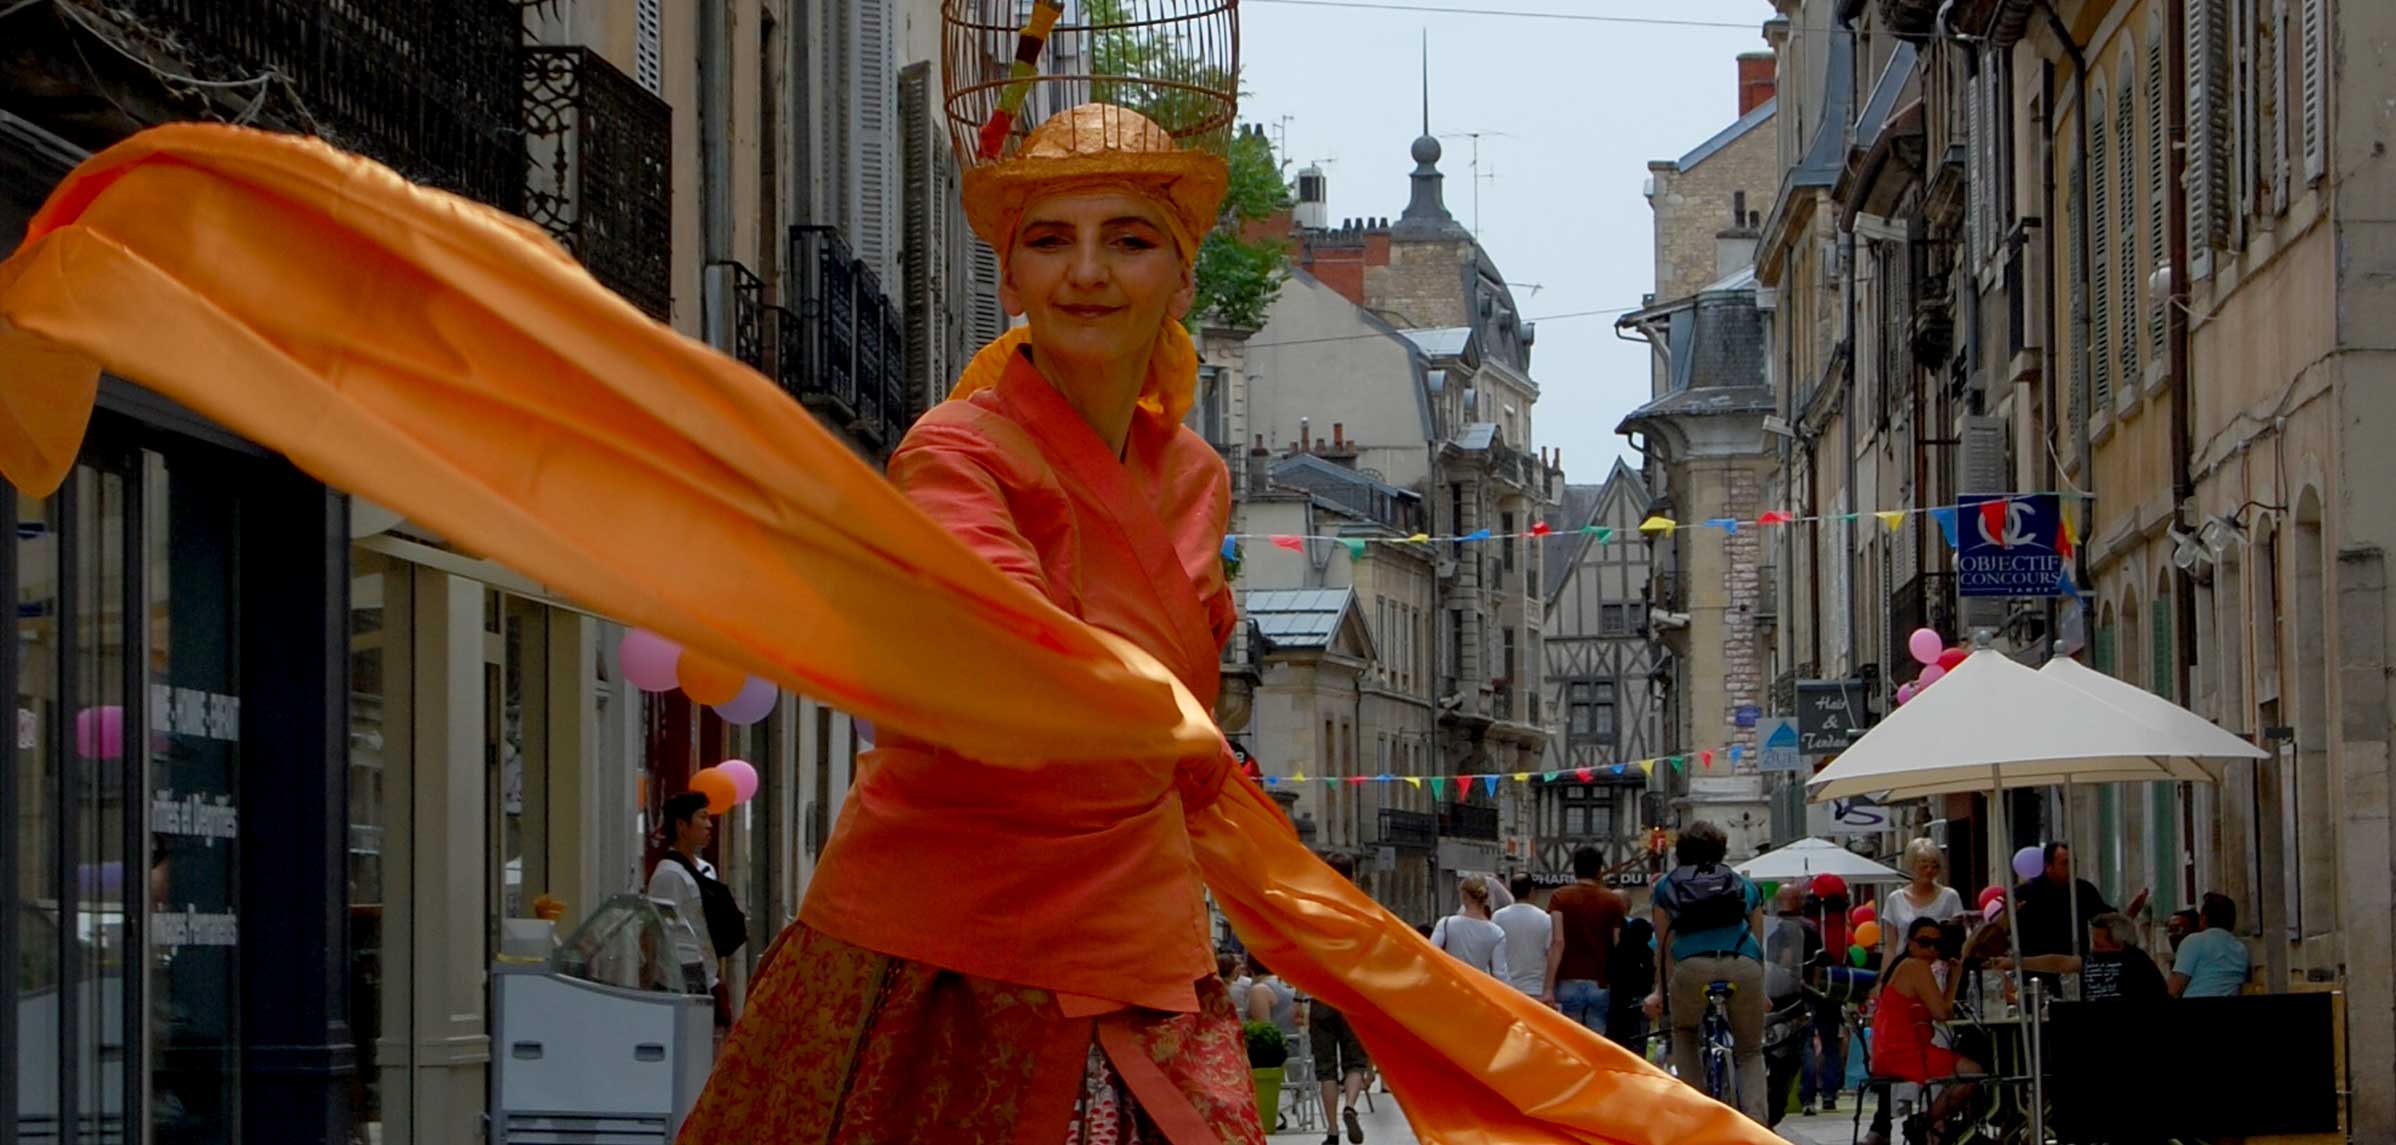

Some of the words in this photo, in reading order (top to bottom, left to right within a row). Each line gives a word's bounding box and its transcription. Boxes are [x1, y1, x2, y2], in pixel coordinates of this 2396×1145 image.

[1959, 555, 2060, 571] OBJECTIF
[1959, 571, 2059, 585] CONCOURS
[1815, 696, 1847, 710] Hair
[1822, 714, 1840, 730] &
[1801, 732, 1849, 750] Tendan
[1620, 872, 1643, 885] DU
